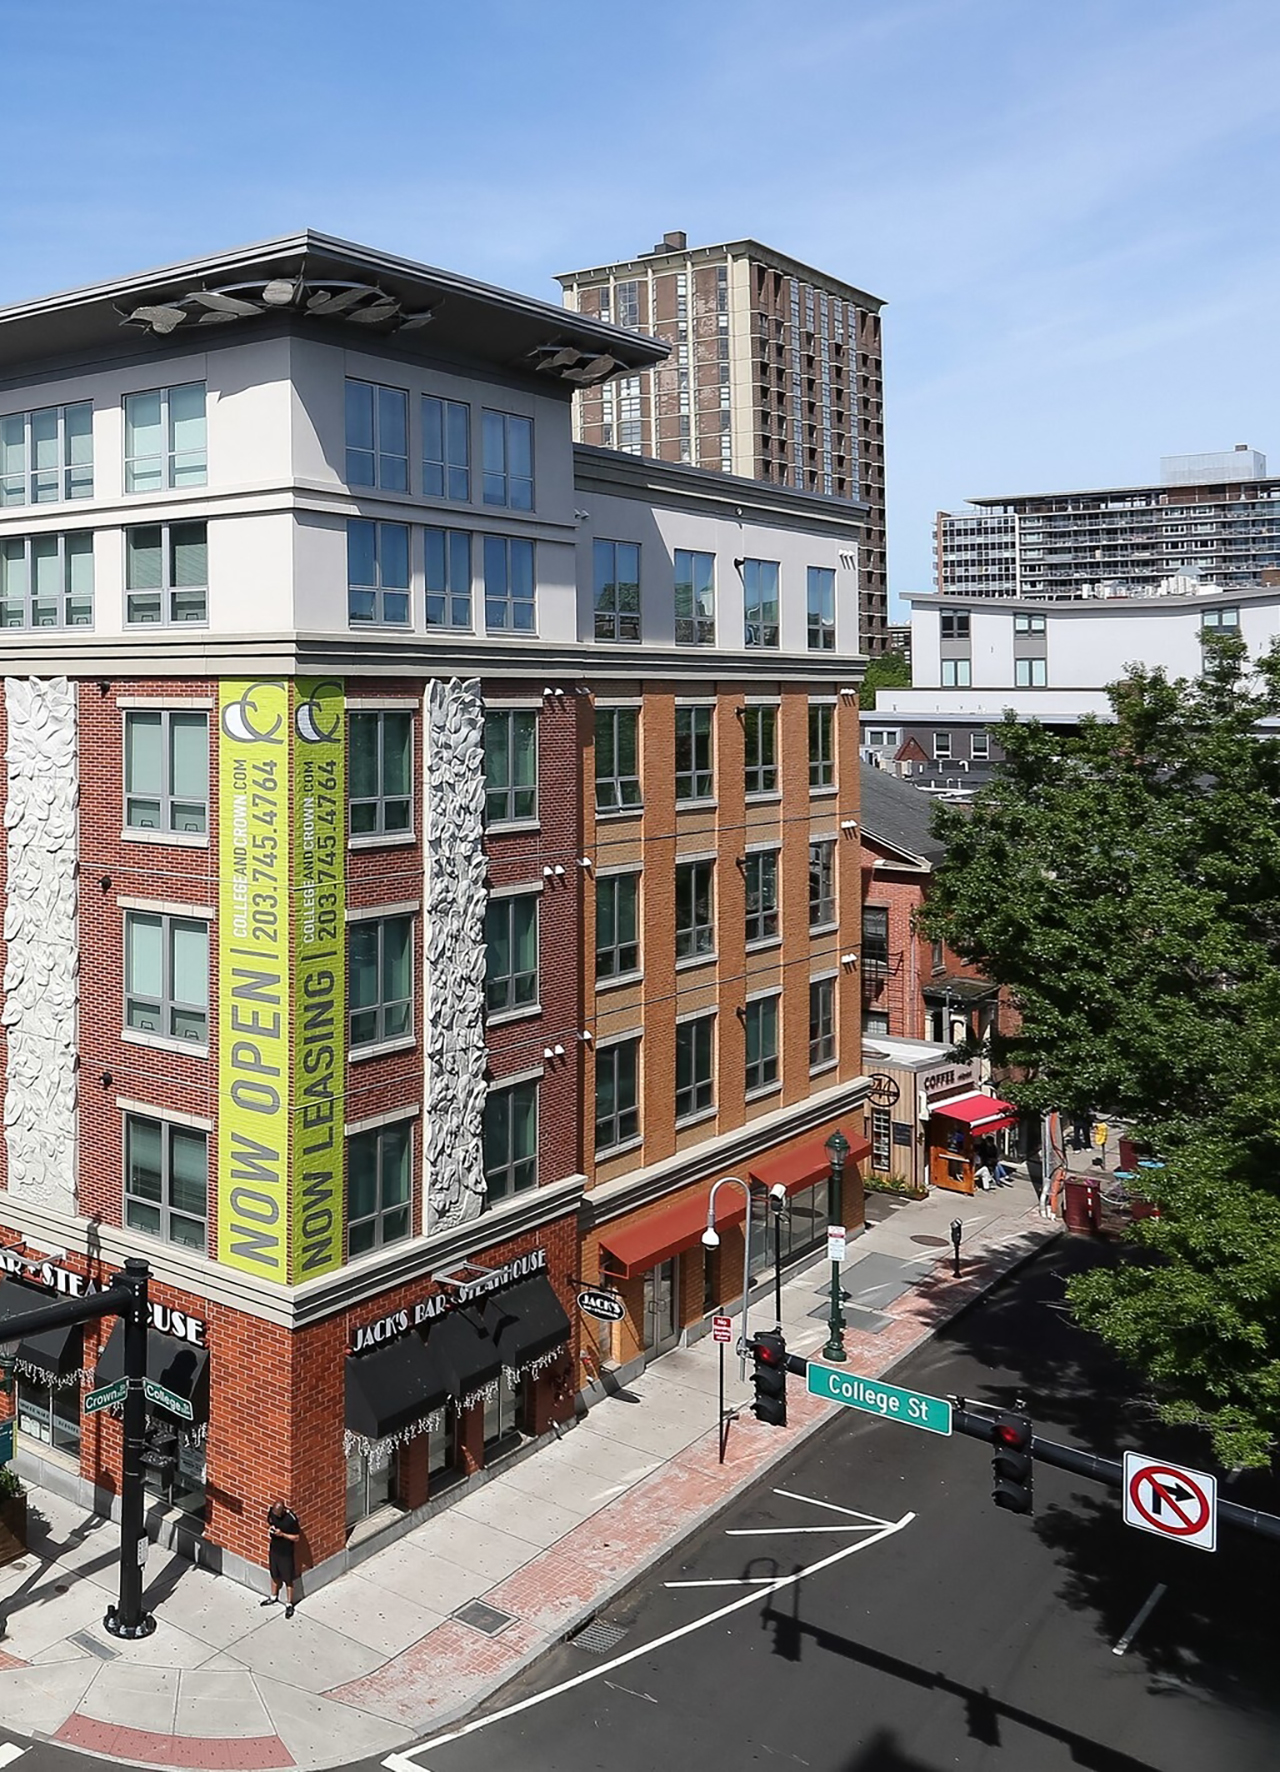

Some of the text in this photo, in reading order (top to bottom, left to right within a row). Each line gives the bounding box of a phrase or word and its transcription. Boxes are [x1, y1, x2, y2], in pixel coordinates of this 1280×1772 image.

[232, 759, 248, 938] COLLEGEANDCROWN.COM
[252, 759, 278, 943] 203.745.4764
[303, 761, 315, 943] COLLEGEANDCROWN.COM
[318, 759, 337, 942] 203.745.4764
[230, 968, 281, 1268] NOW OPEN
[302, 969, 335, 1272] NOW LEASING
[924, 1070, 955, 1091] COFFEE
[353, 1309, 409, 1352] JACK'S
[415, 1293, 446, 1325] BAR
[581, 1294, 621, 1314] JACK'S
[85, 1389, 117, 1410] Crown
[146, 1384, 182, 1411] College
[828, 1374, 929, 1421] College St
